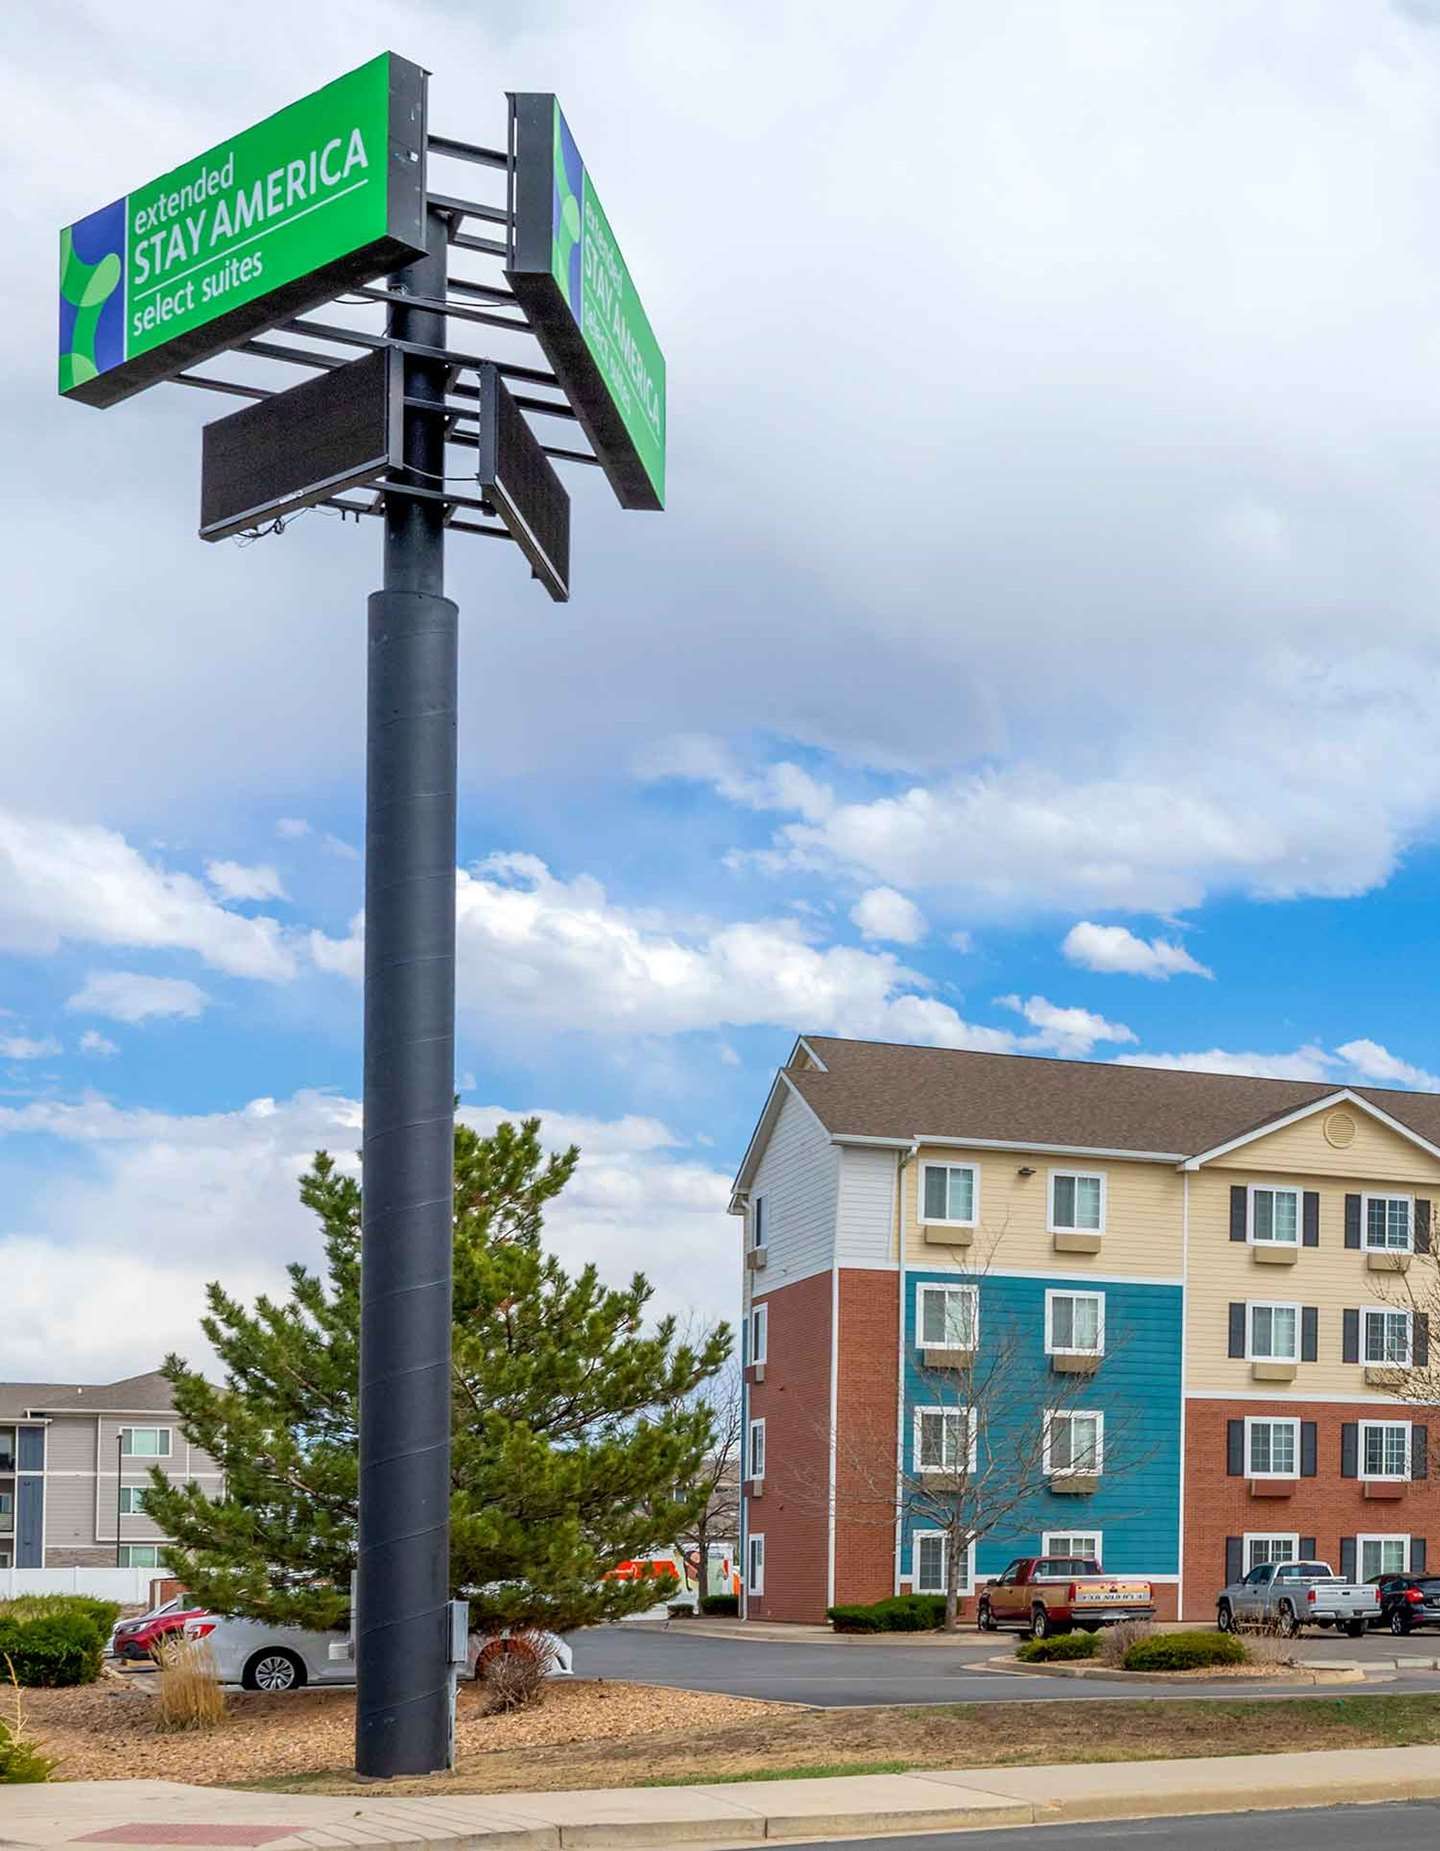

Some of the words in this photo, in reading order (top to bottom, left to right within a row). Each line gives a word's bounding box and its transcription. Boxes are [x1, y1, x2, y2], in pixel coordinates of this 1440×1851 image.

[134, 152, 235, 235] extended
[134, 210, 206, 285] STAY
[209, 127, 369, 248] AMERICA
[133, 282, 195, 336] select
[201, 251, 263, 302] suites
[584, 233, 613, 321] STAY
[612, 302, 661, 436] AMERICA
